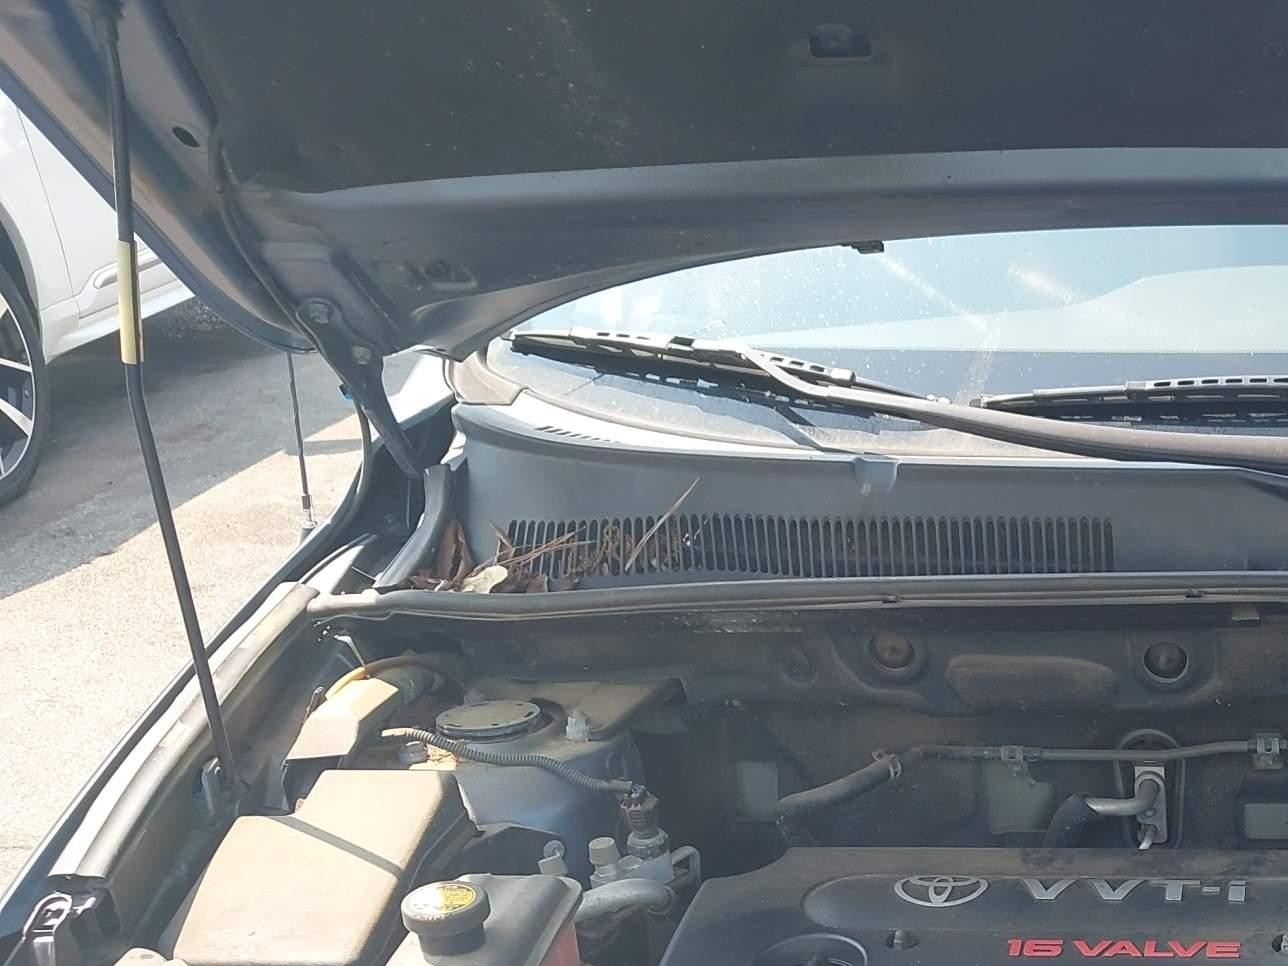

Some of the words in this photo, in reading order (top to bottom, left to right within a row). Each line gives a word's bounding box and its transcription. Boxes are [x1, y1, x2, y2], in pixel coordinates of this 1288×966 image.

[1023, 879, 1247, 902] VVT-i
[1007, 939, 1064, 957] 16
[1073, 939, 1241, 958] VALVE
